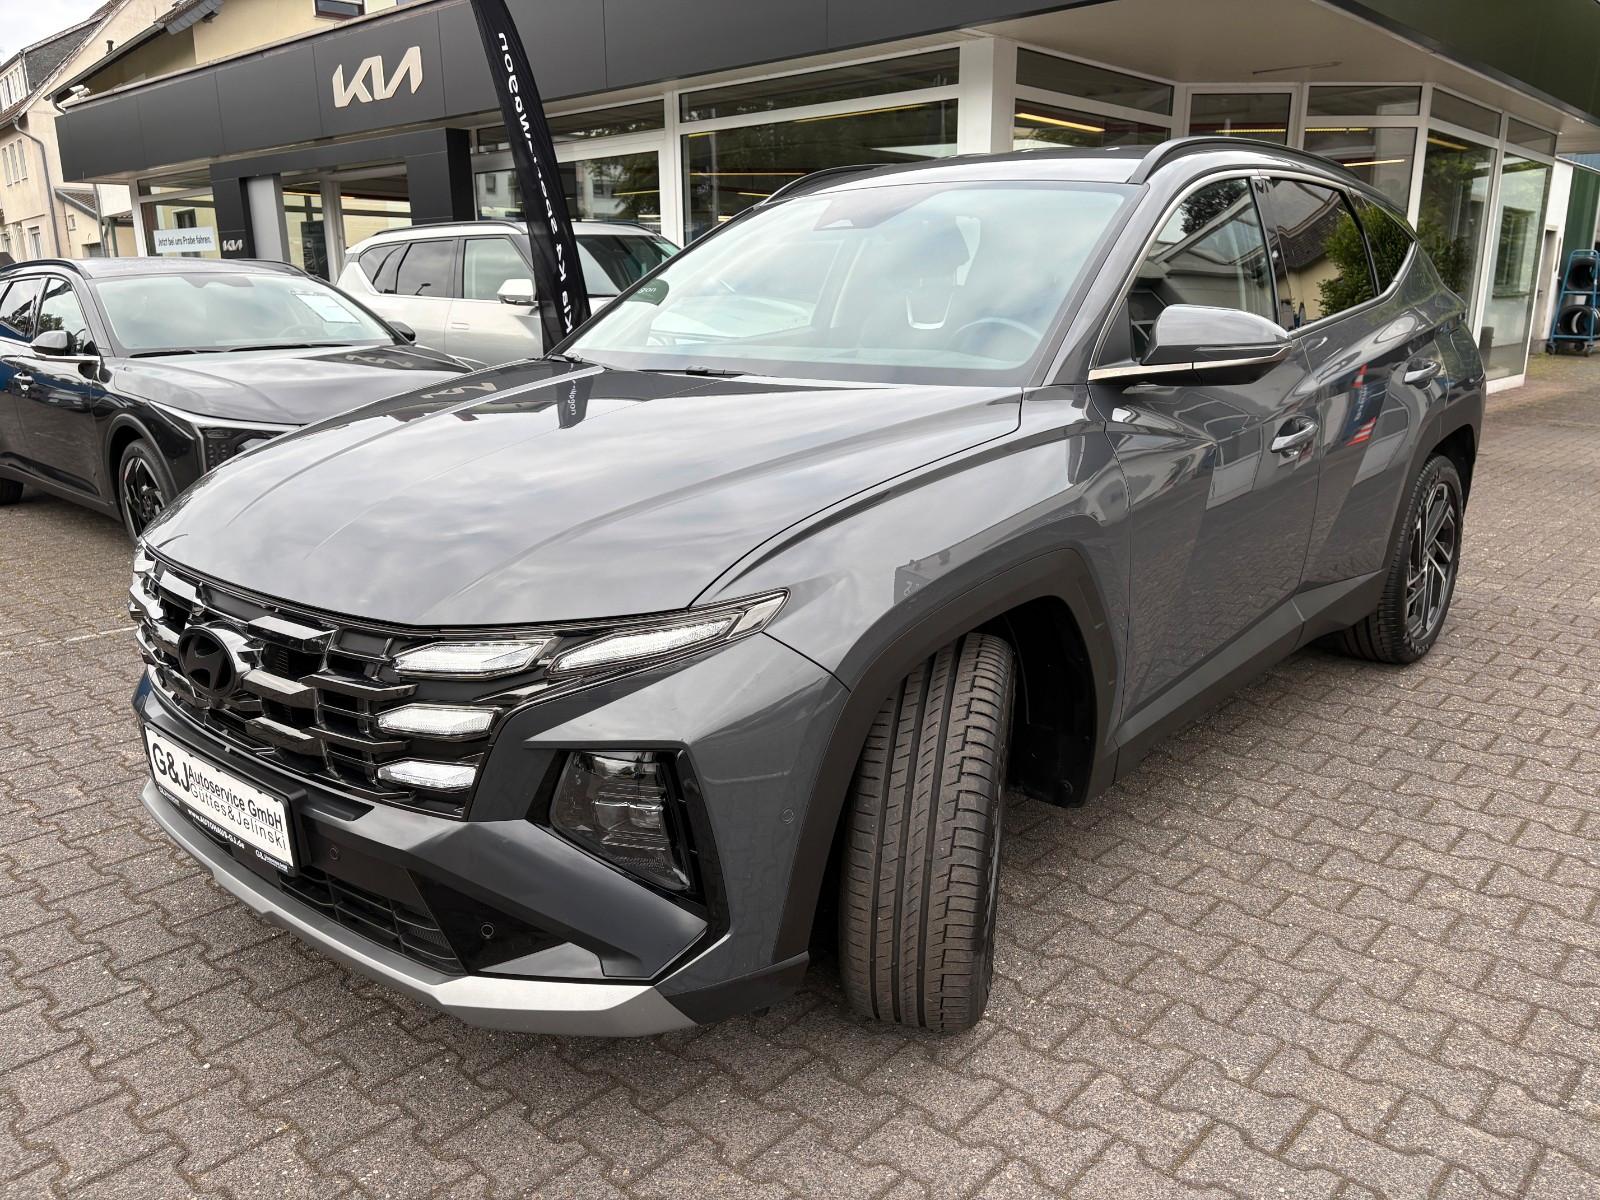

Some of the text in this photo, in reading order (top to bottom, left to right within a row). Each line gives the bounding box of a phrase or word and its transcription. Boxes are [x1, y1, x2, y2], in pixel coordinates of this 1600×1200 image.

[152, 742, 191, 793] G&J
[188, 764, 246, 812] Autoservice
[247, 799, 283, 832] GmbH
